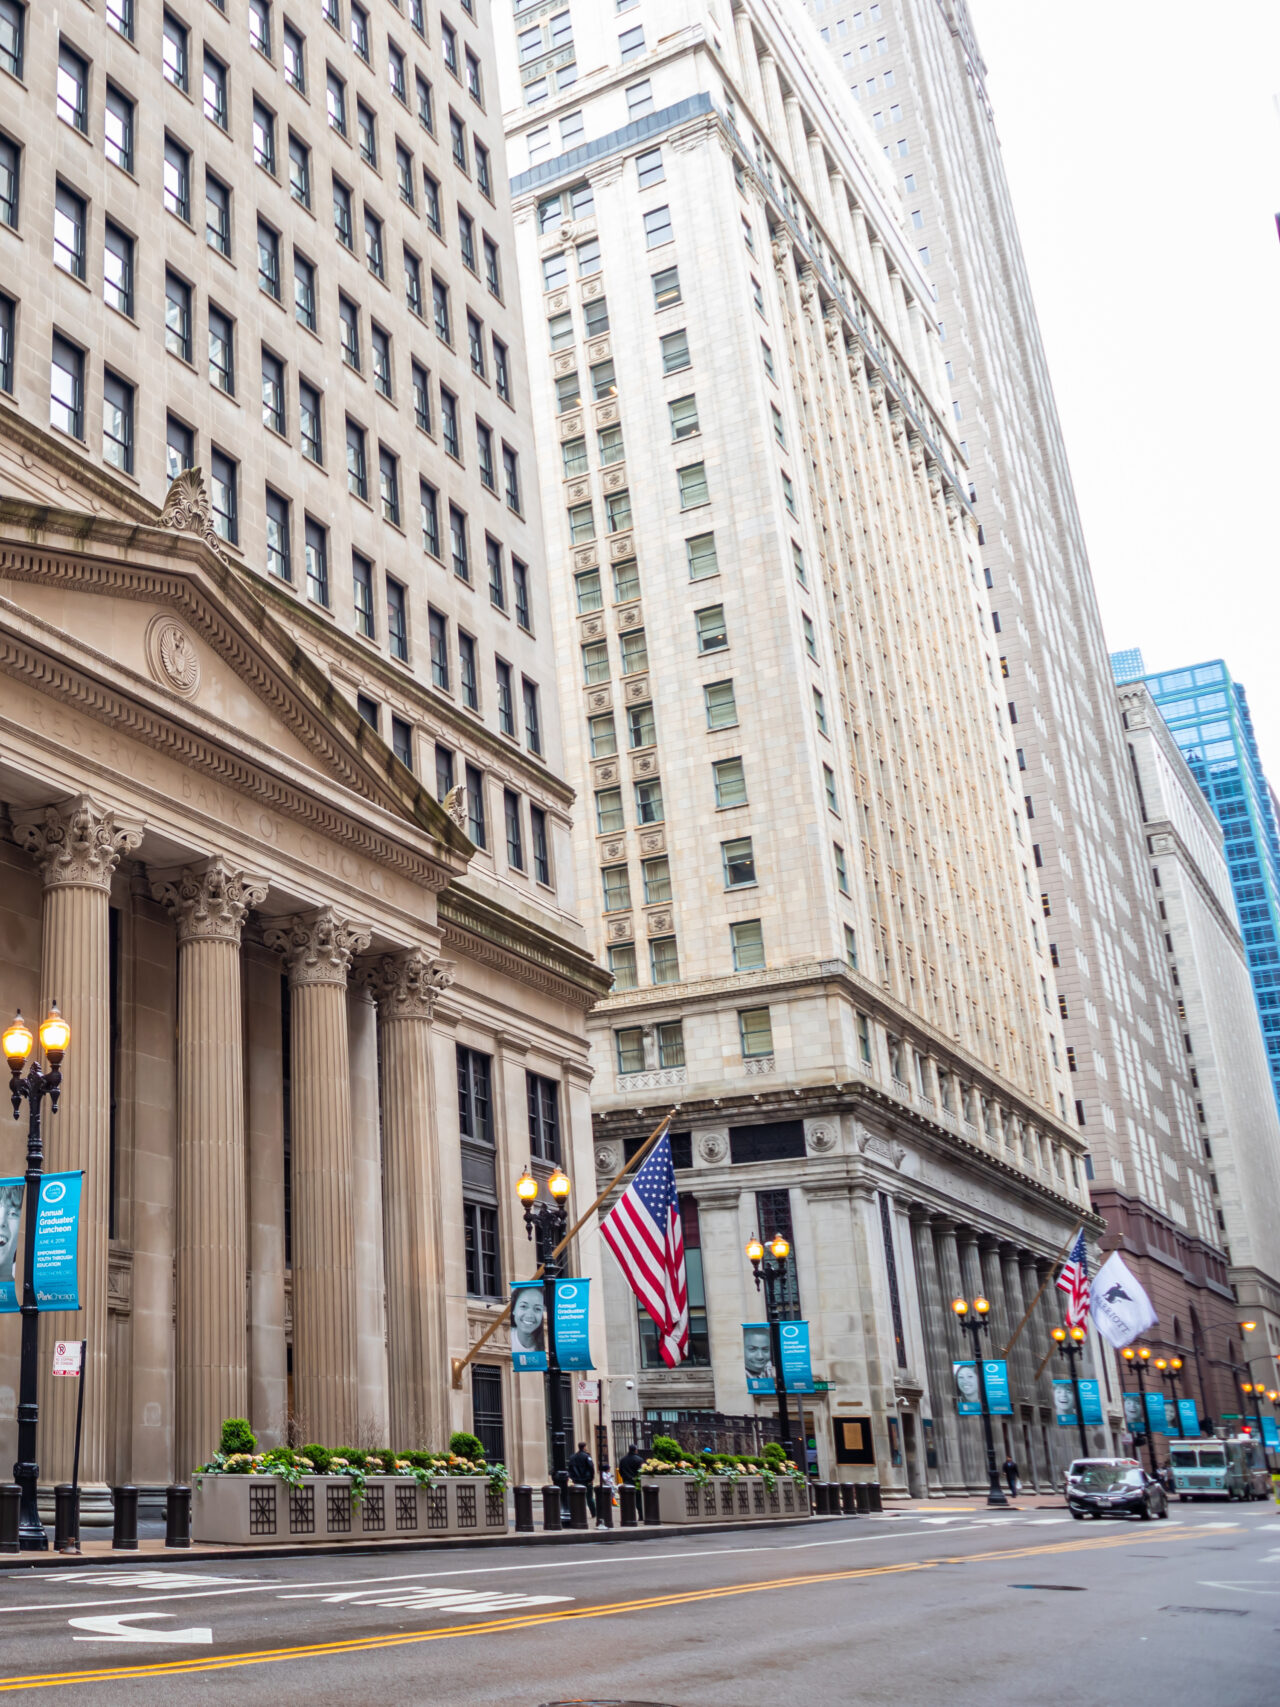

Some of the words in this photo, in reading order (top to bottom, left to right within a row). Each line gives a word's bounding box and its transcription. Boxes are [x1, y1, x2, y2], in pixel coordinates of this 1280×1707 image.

[30, 697, 157, 783] RESERVE
[181, 773, 245, 825] BANK
[257, 813, 284, 844] OF
[299, 834, 397, 899] CHICAGO
[40, 1208, 64, 1218] Annual
[39, 1215, 75, 1226] Graduates'
[38, 1225, 72, 1235] Luncheon
